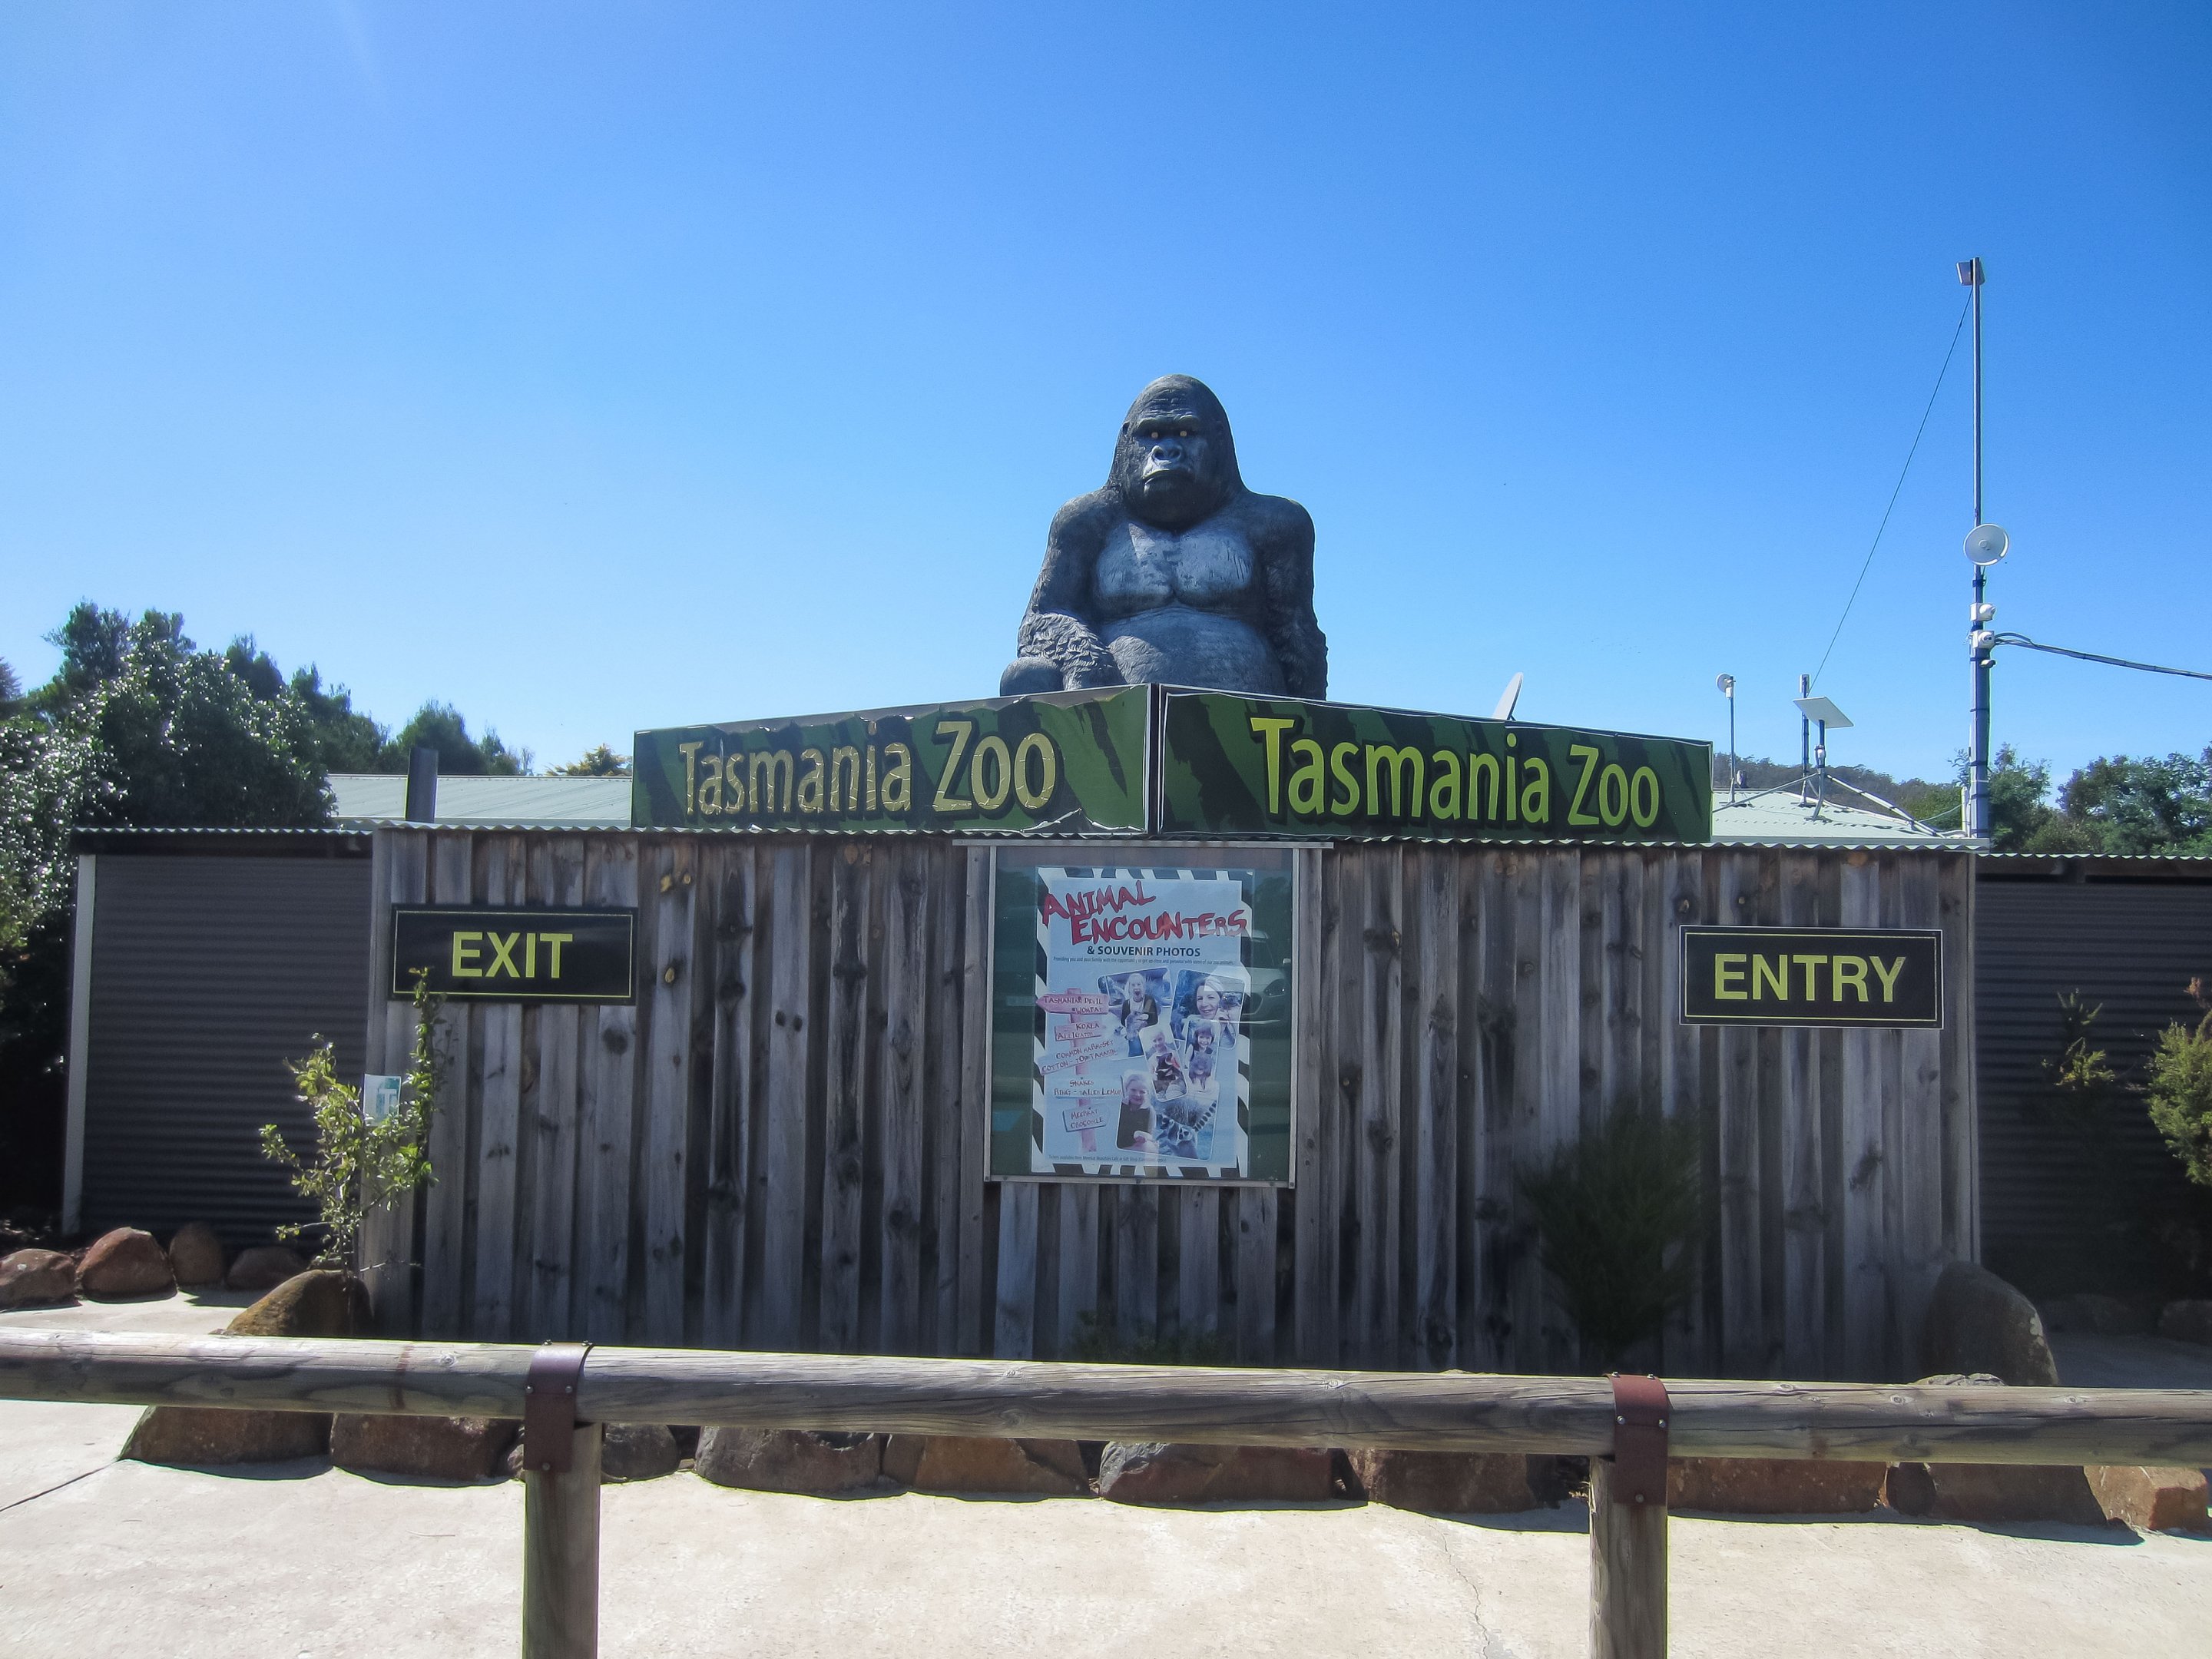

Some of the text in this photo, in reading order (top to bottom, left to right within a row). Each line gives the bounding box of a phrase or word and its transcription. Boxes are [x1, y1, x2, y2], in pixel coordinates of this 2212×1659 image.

[679, 720, 1056, 816] Tasmania Zoo
[1250, 717, 1659, 828] Tasmania Zoo
[1042, 879, 1157, 929] ANIMAL
[1071, 909, 1247, 945] ENCOUNTERS
[452, 932, 573, 979] EXIT
[1087, 945, 1200, 957] & SOUVENIR PHOTOS
[1715, 953, 1906, 1002] ENTRY
